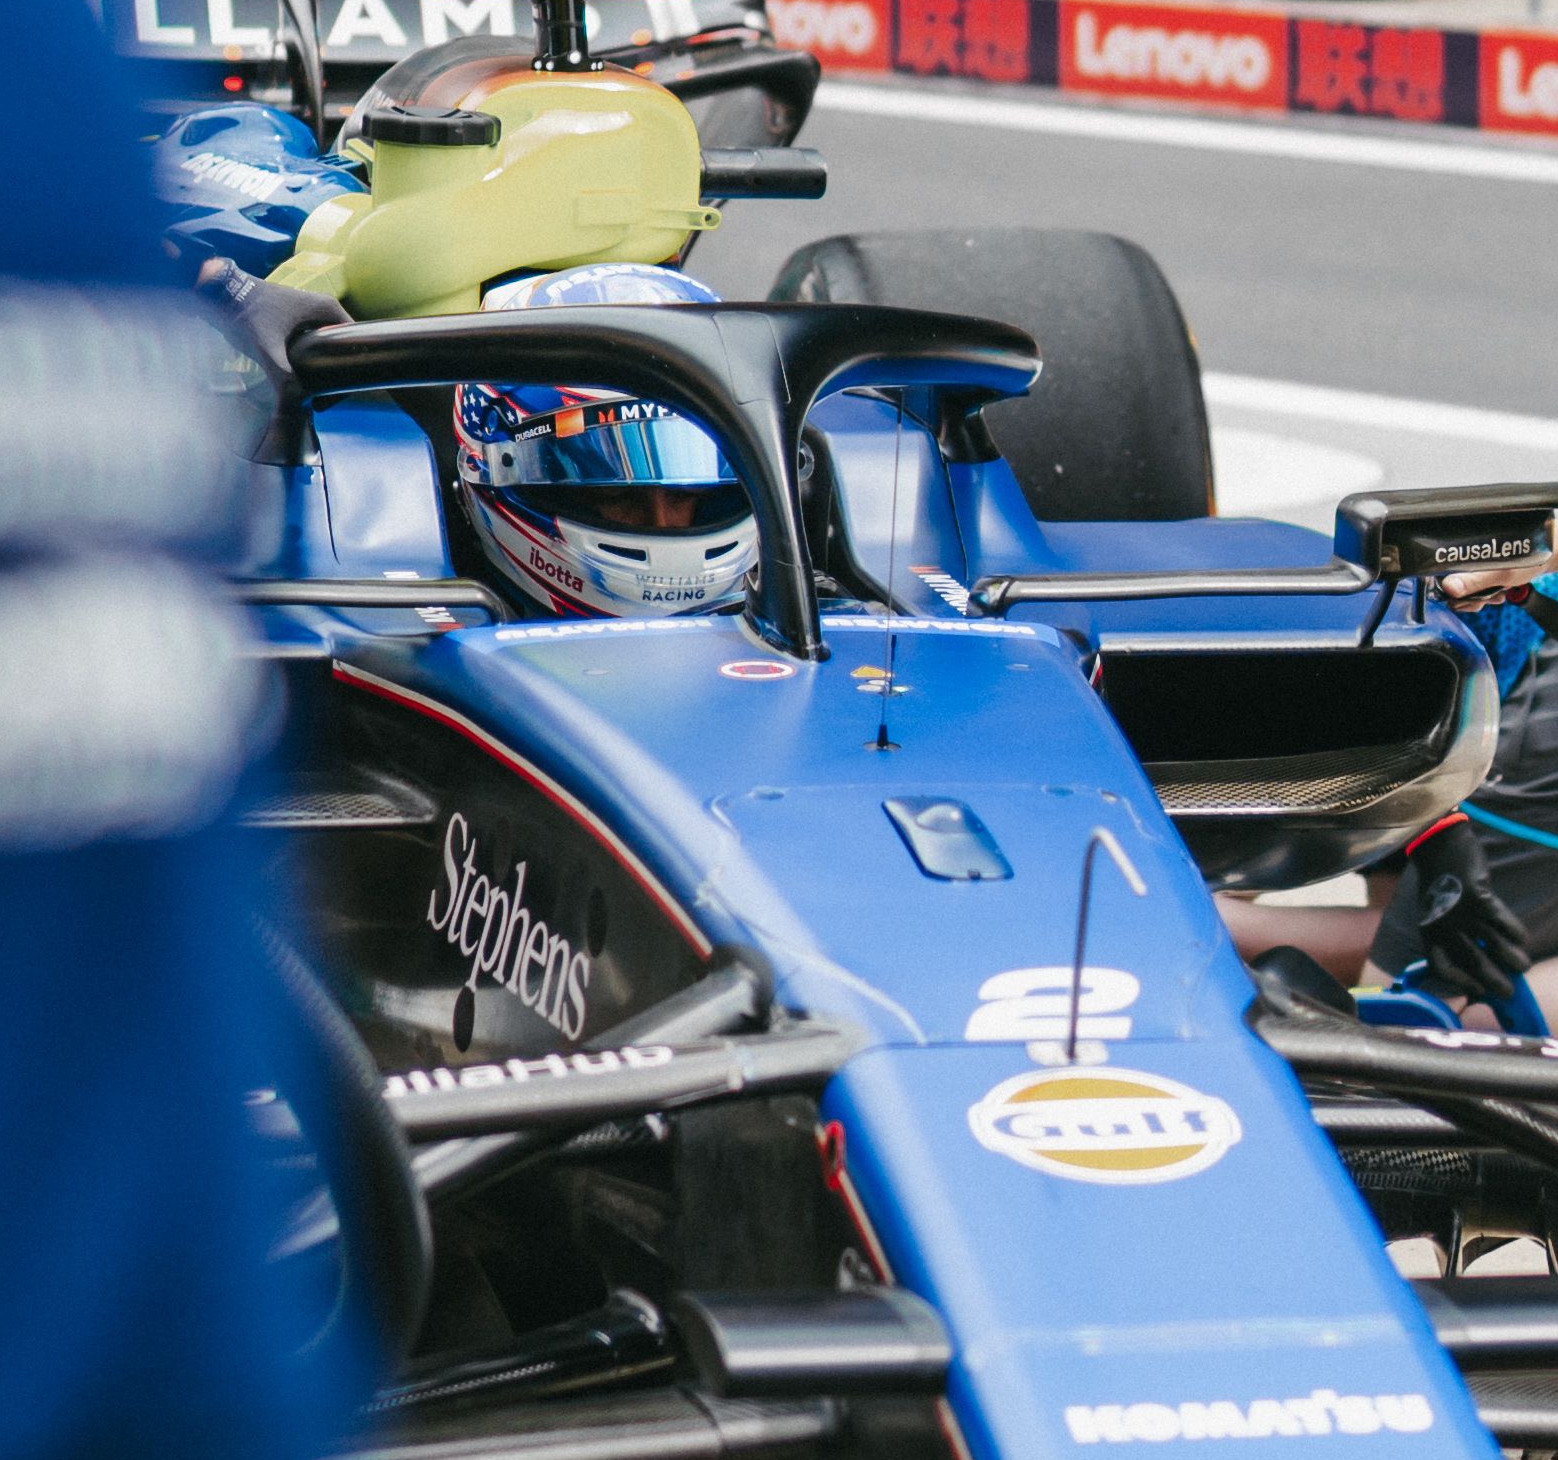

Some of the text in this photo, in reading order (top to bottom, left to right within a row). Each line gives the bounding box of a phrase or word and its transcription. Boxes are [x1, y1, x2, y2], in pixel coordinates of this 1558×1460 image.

[1075, 10, 1272, 72] Lenovo
[515, 423, 552, 443] DURACELL
[529, 546, 585, 594] ibotta
[1434, 537, 1532, 564] causaLens
[642, 588, 707, 602] RACING
[427, 812, 590, 1042] Stephens
[964, 965, 1141, 1041] 2
[992, 1108, 1211, 1140] Gulf
[1063, 1389, 1435, 1444] KOMATSU
